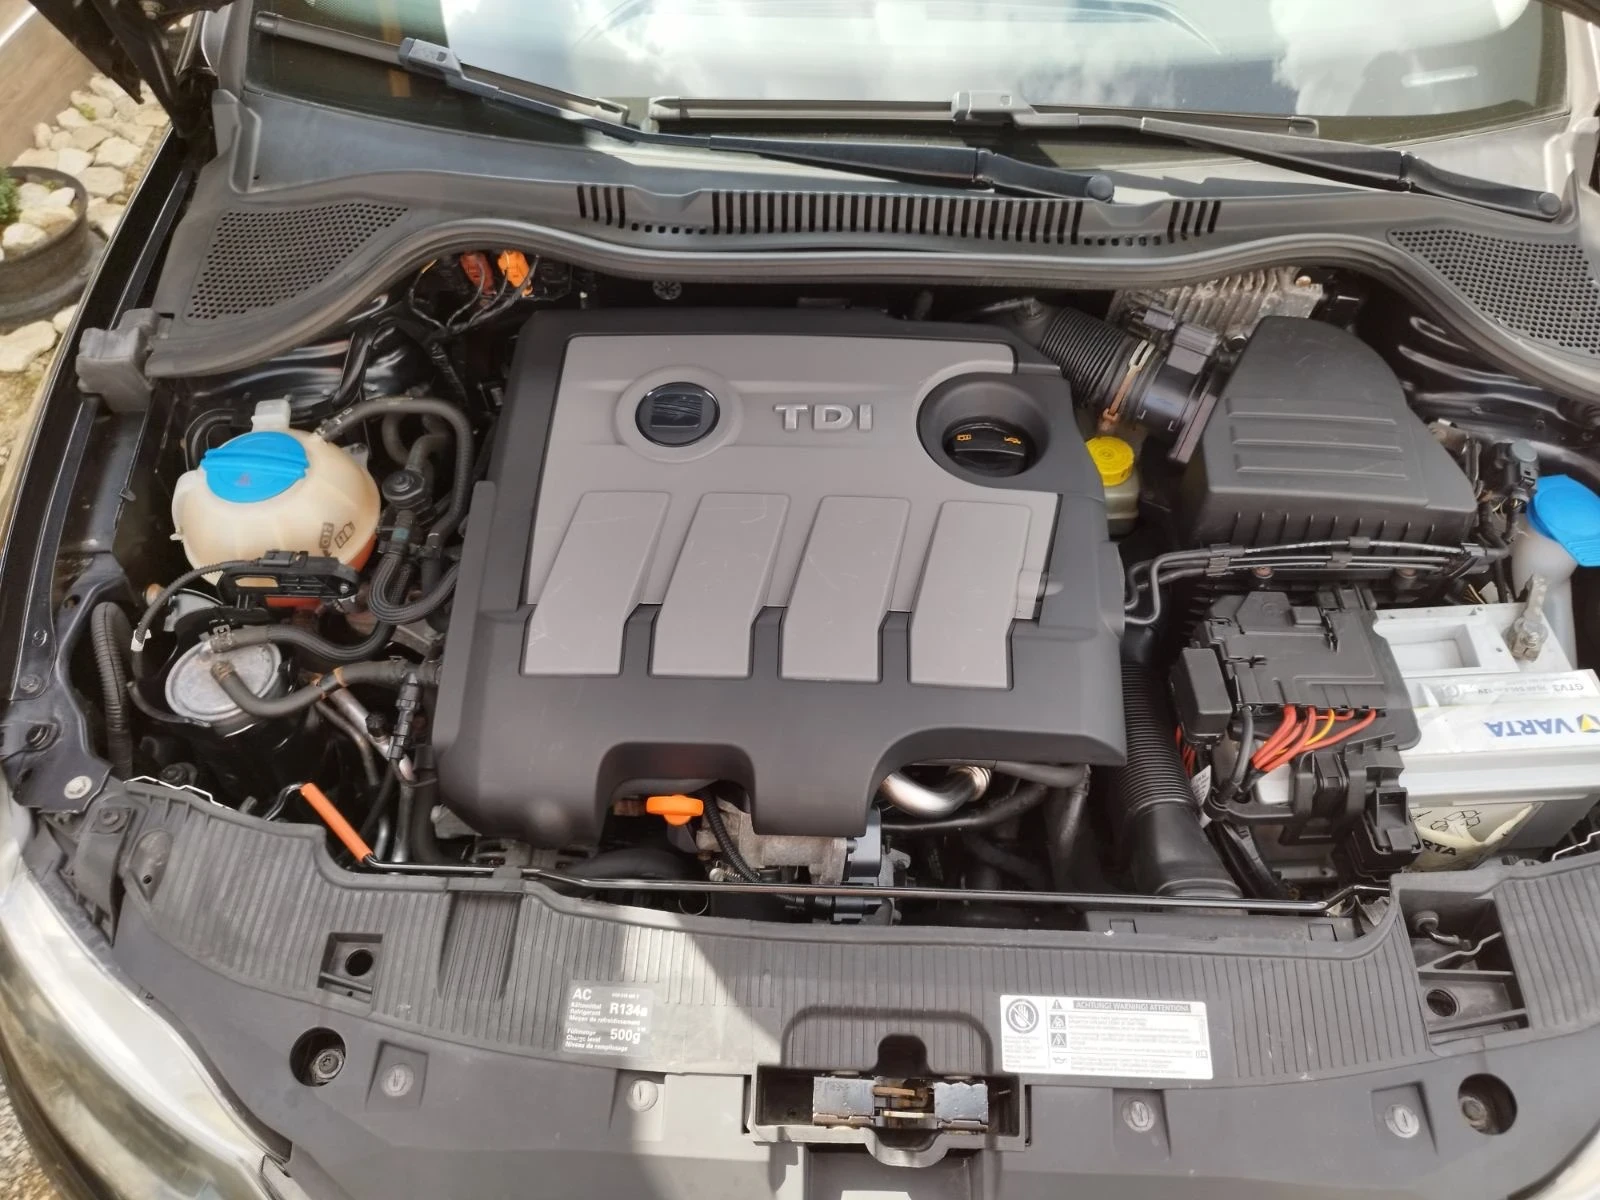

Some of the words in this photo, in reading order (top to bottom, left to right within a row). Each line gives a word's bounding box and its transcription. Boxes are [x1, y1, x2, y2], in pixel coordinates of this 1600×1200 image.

[773, 403, 873, 431] TDI
[1484, 718, 1575, 737] VARTA
[1421, 838, 1458, 856] RTA
[572, 988, 592, 1000] AC
[609, 1002, 648, 1017] R134a
[610, 1028, 640, 1044] 500g
